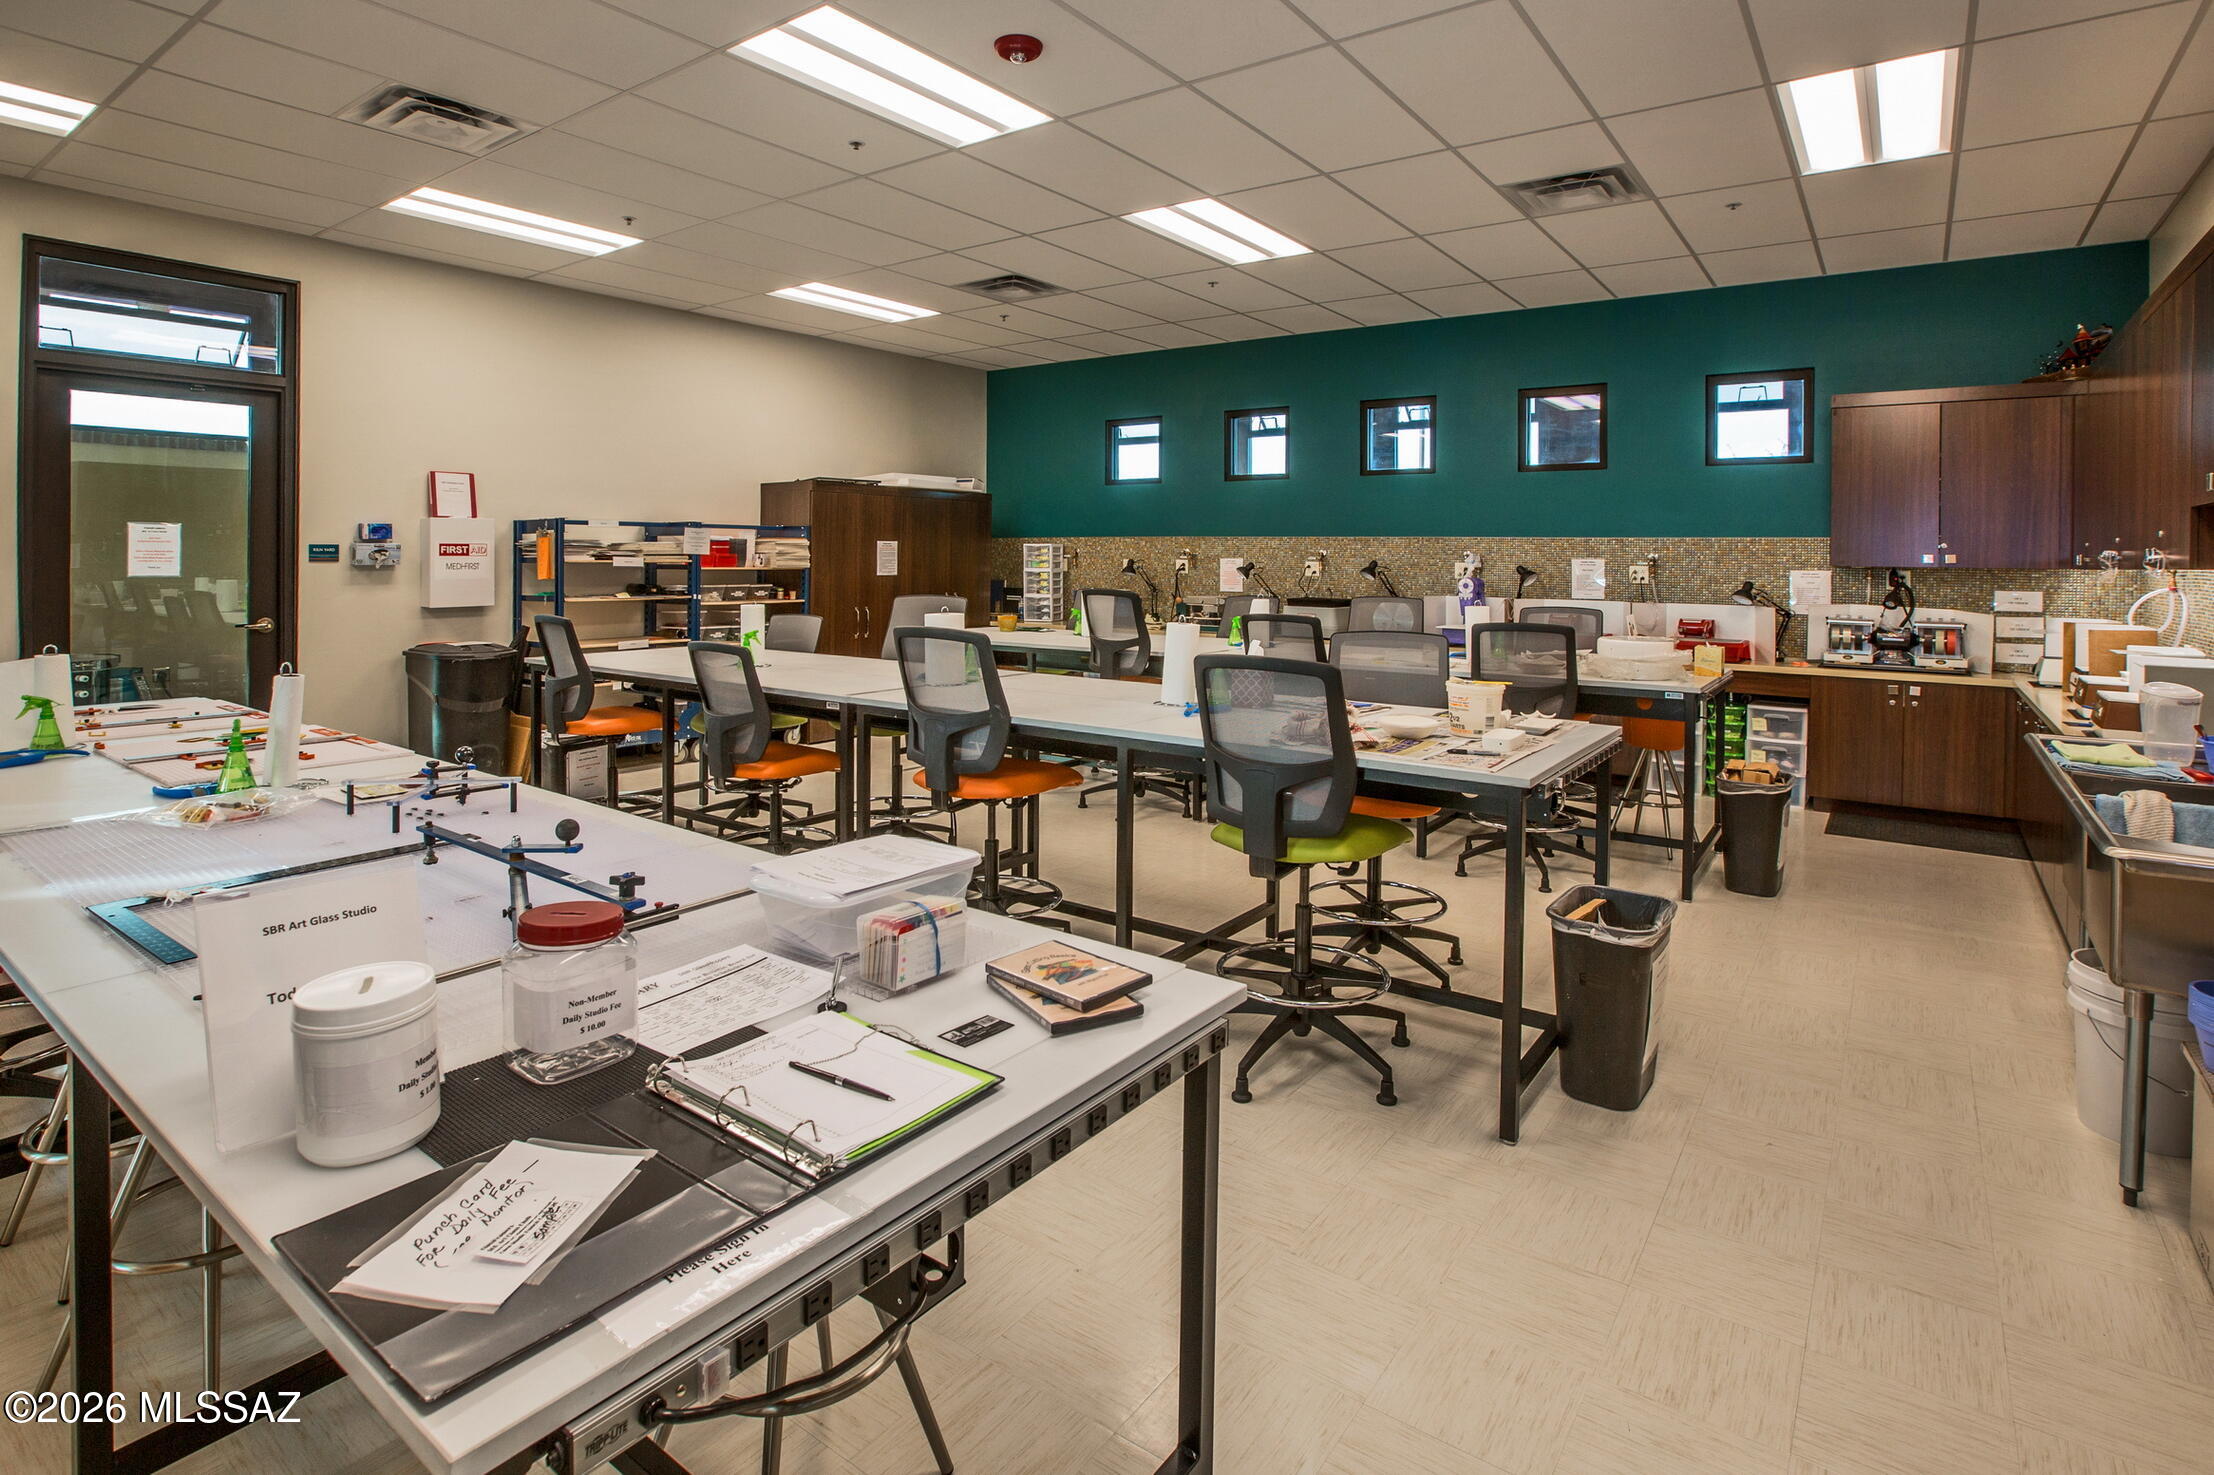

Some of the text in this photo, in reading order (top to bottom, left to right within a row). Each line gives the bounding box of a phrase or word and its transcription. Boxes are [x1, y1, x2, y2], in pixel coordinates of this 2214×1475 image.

[440, 545, 487, 554] FIRST AID
[262, 905, 377, 937] SBR Art Glass Studio
[266, 986, 297, 1005] Tod
[568, 990, 617, 1008] Non-Member
[562, 1002, 622, 1025] Daily Studio Fee
[398, 1078, 420, 1093] Daily
[413, 1212, 457, 1251] Punch
[459, 1179, 493, 1209] Card
[451, 1207, 487, 1236] Daily
[490, 1179, 517, 1200] Fee
[664, 1223, 770, 1284] Please Sign In
[711, 1250, 753, 1275] Here
